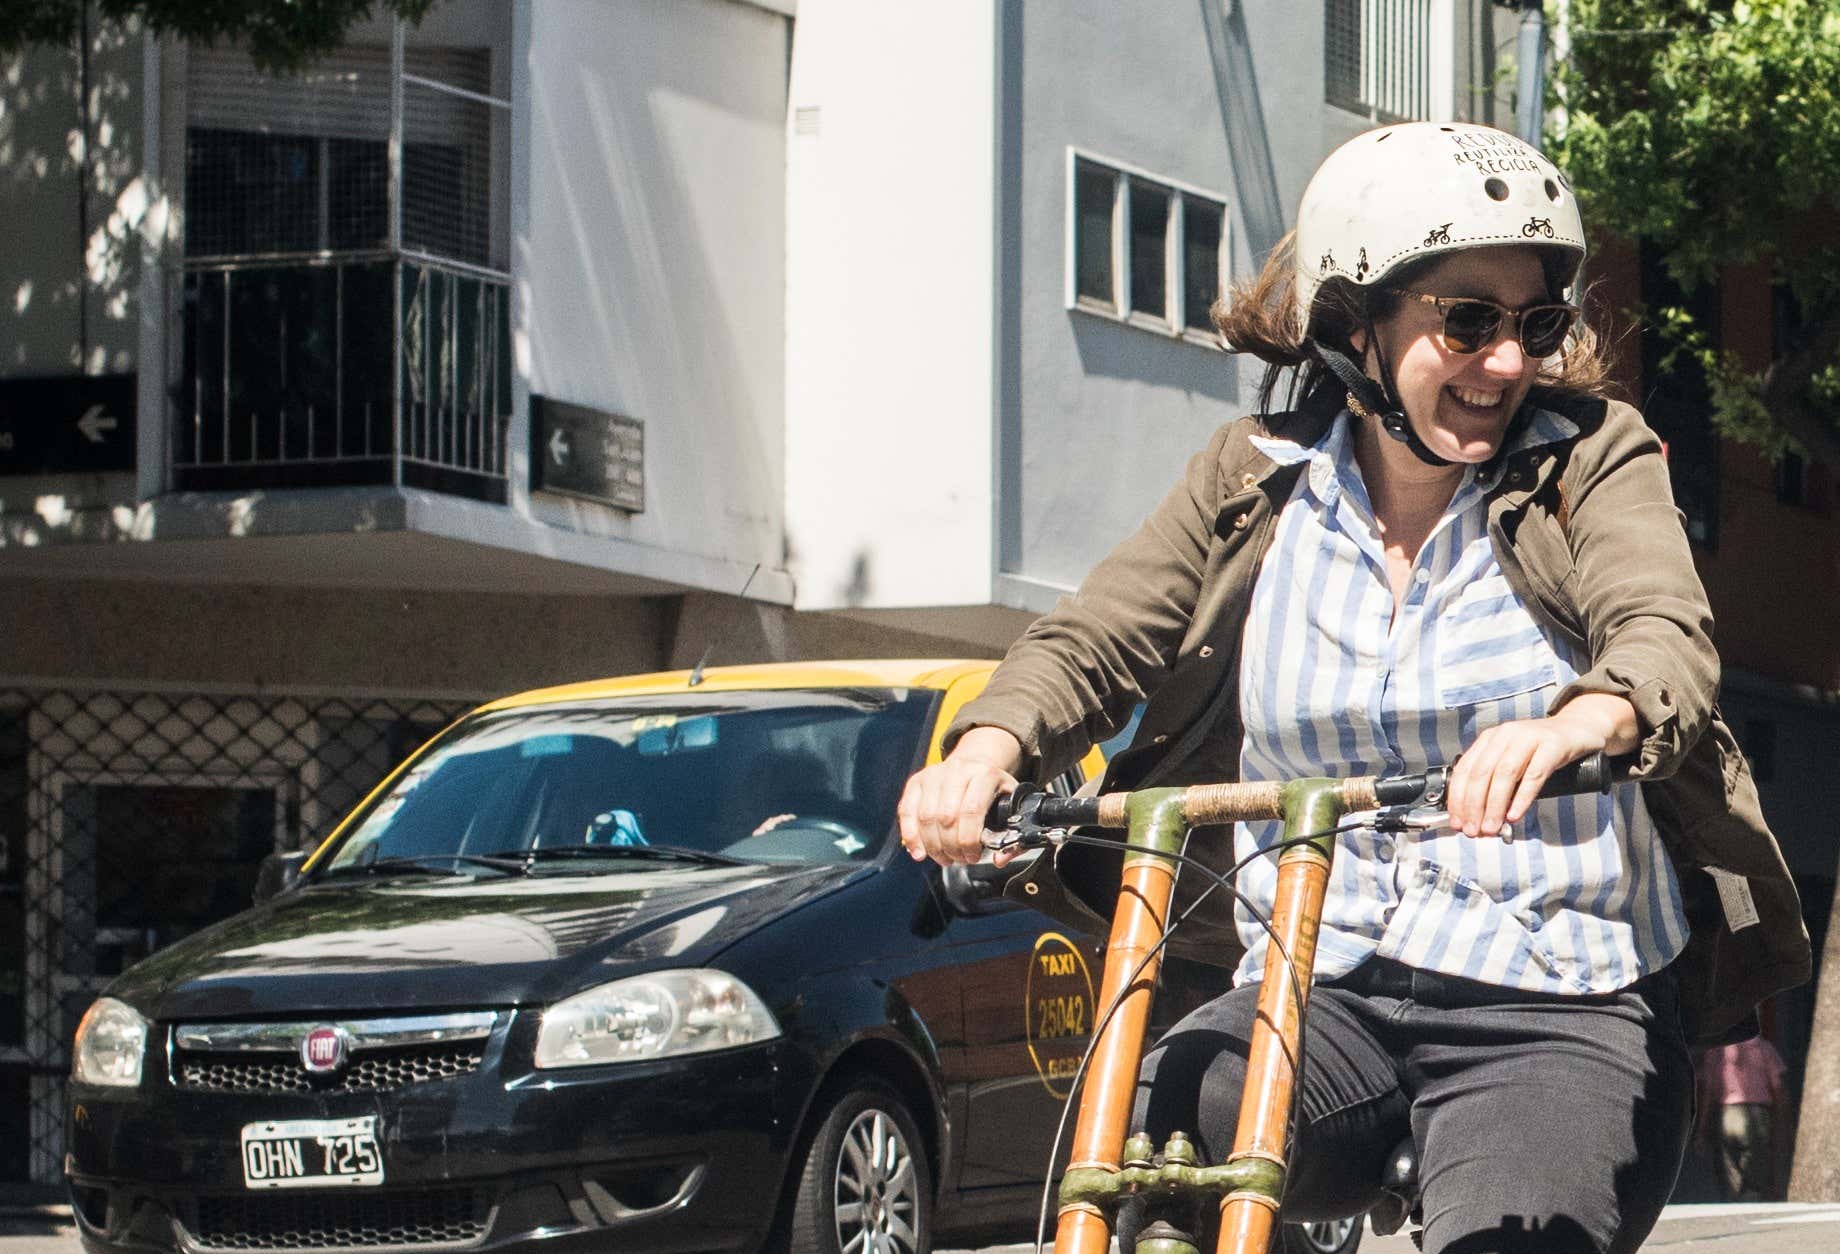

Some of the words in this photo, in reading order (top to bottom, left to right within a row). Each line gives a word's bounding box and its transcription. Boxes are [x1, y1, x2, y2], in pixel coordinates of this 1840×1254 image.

[1475, 158, 1543, 177] RECICLA
[1040, 953, 1076, 976] TAXI
[1039, 995, 1084, 1039] 25042
[310, 1037, 336, 1060] FIAT
[247, 1140, 304, 1178] OHN
[318, 1135, 377, 1174] 725
